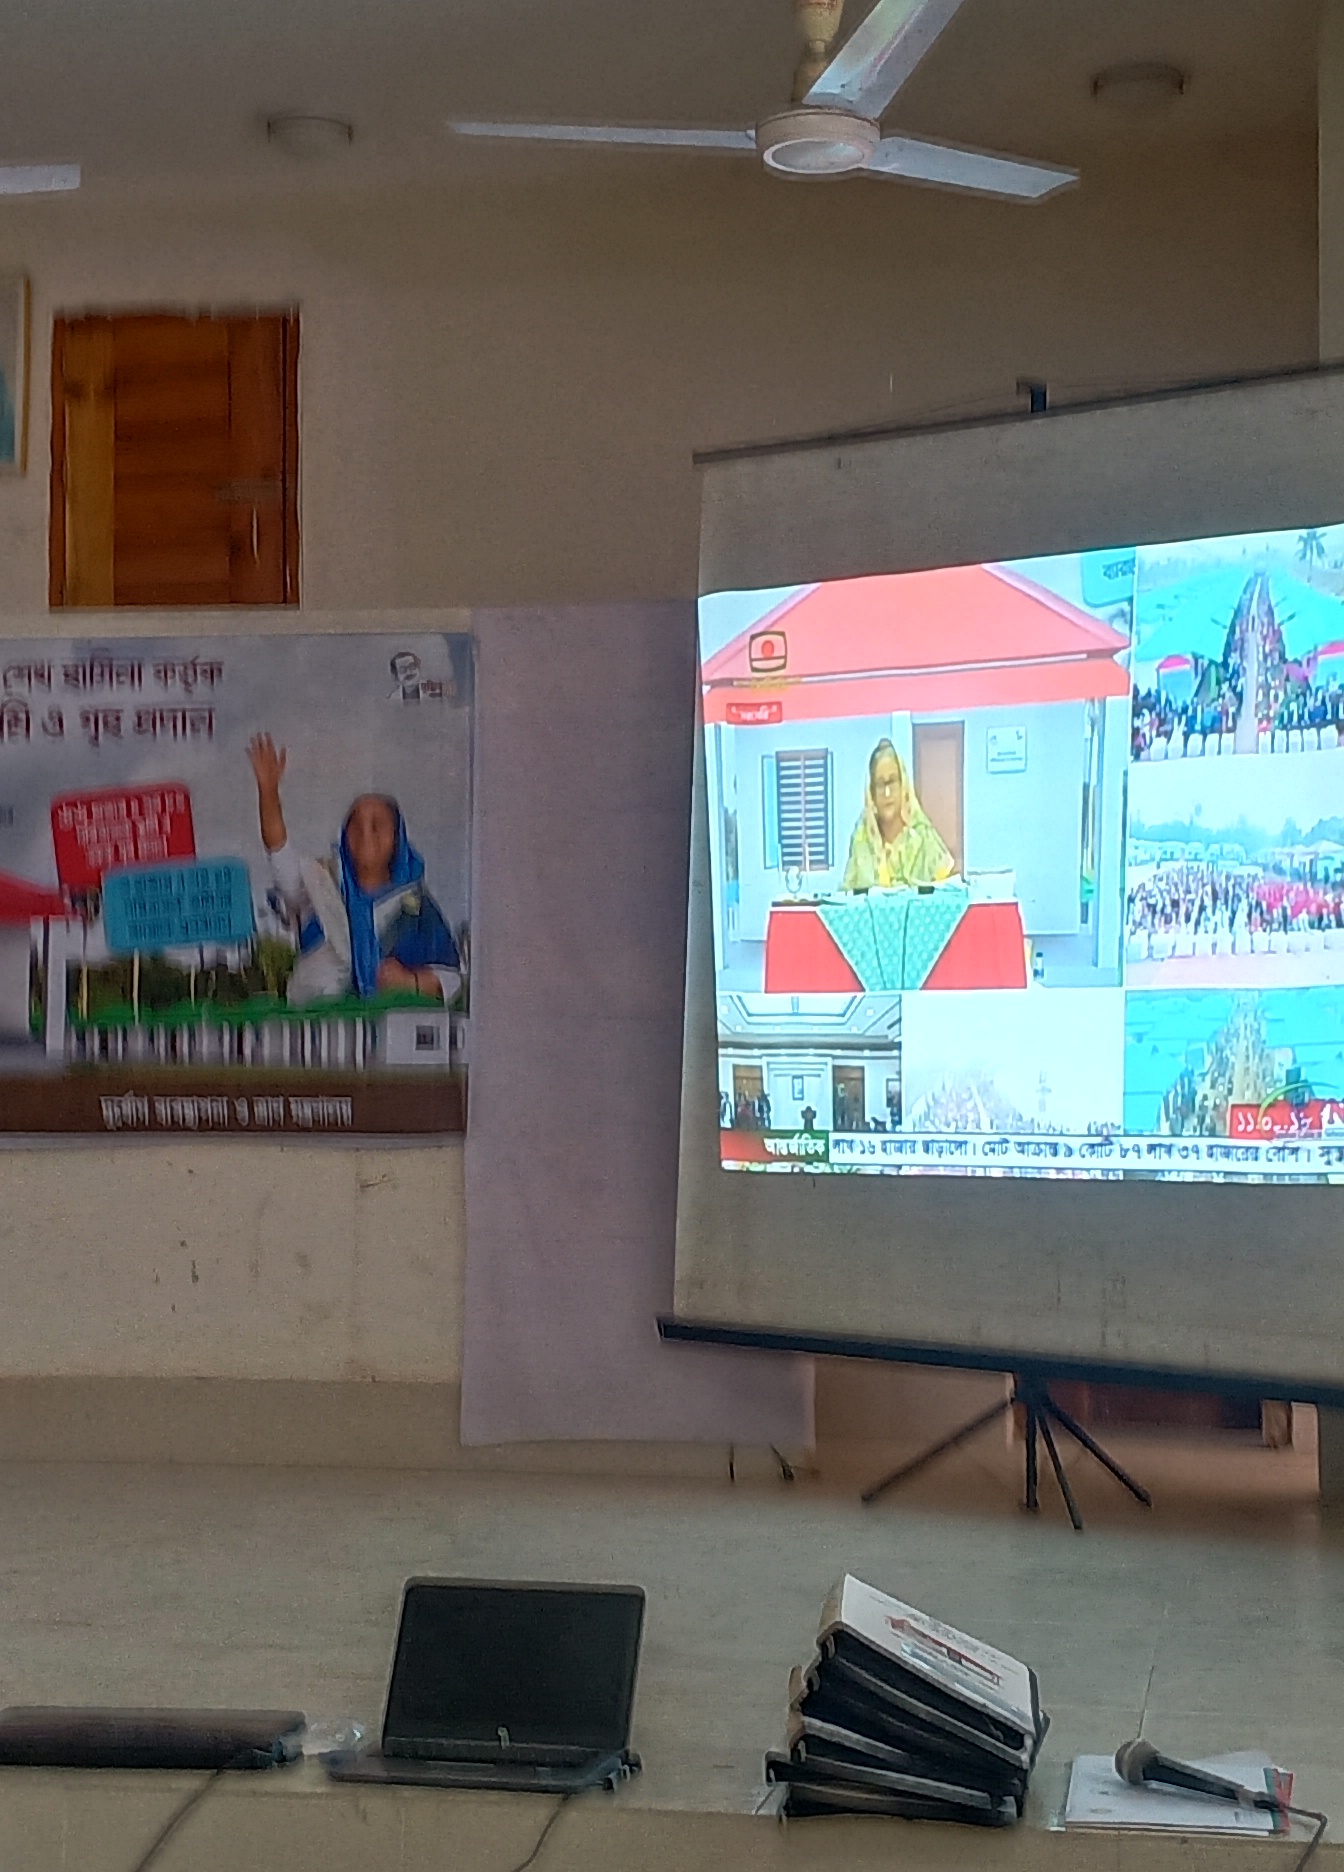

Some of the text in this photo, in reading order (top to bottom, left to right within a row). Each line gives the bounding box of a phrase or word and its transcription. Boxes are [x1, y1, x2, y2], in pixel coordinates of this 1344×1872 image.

[2, 664, 52, 697] শেখ
[61, 649, 142, 692] হাসিনা
[42, 706, 64, 738] ও
[859, 1139, 876, 1155] ১৬
[1119, 1143, 1142, 1159] ৮৭
